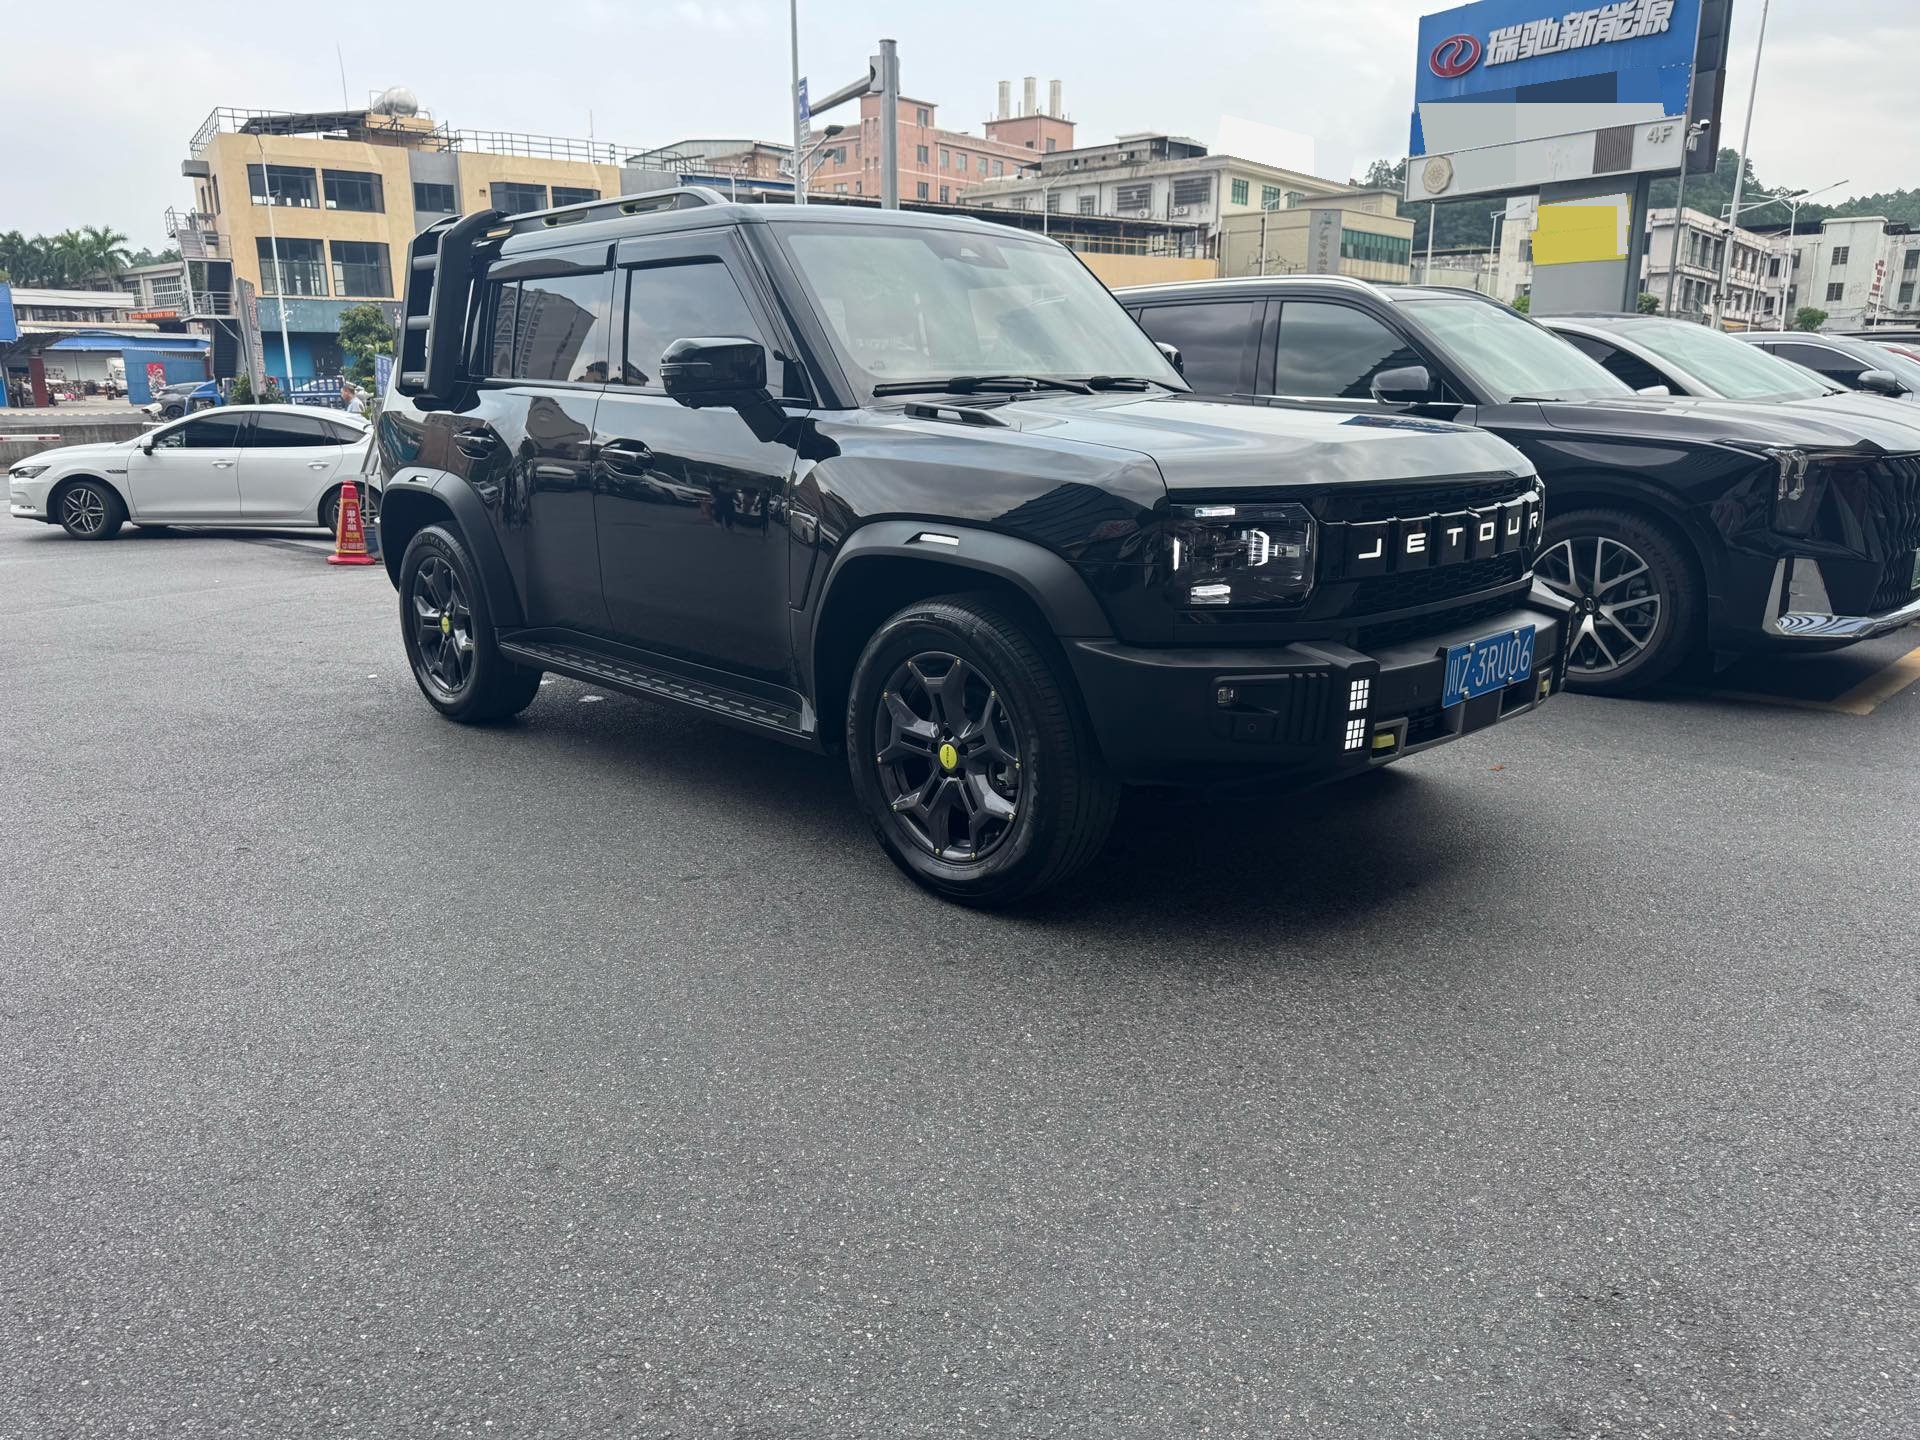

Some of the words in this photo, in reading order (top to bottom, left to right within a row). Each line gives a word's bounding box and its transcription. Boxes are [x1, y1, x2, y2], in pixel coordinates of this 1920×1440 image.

[1484, 0, 1676, 67] 瑞驰新能源
[1646, 125, 1673, 144] 4F
[1357, 511, 1540, 560] JETOUR
